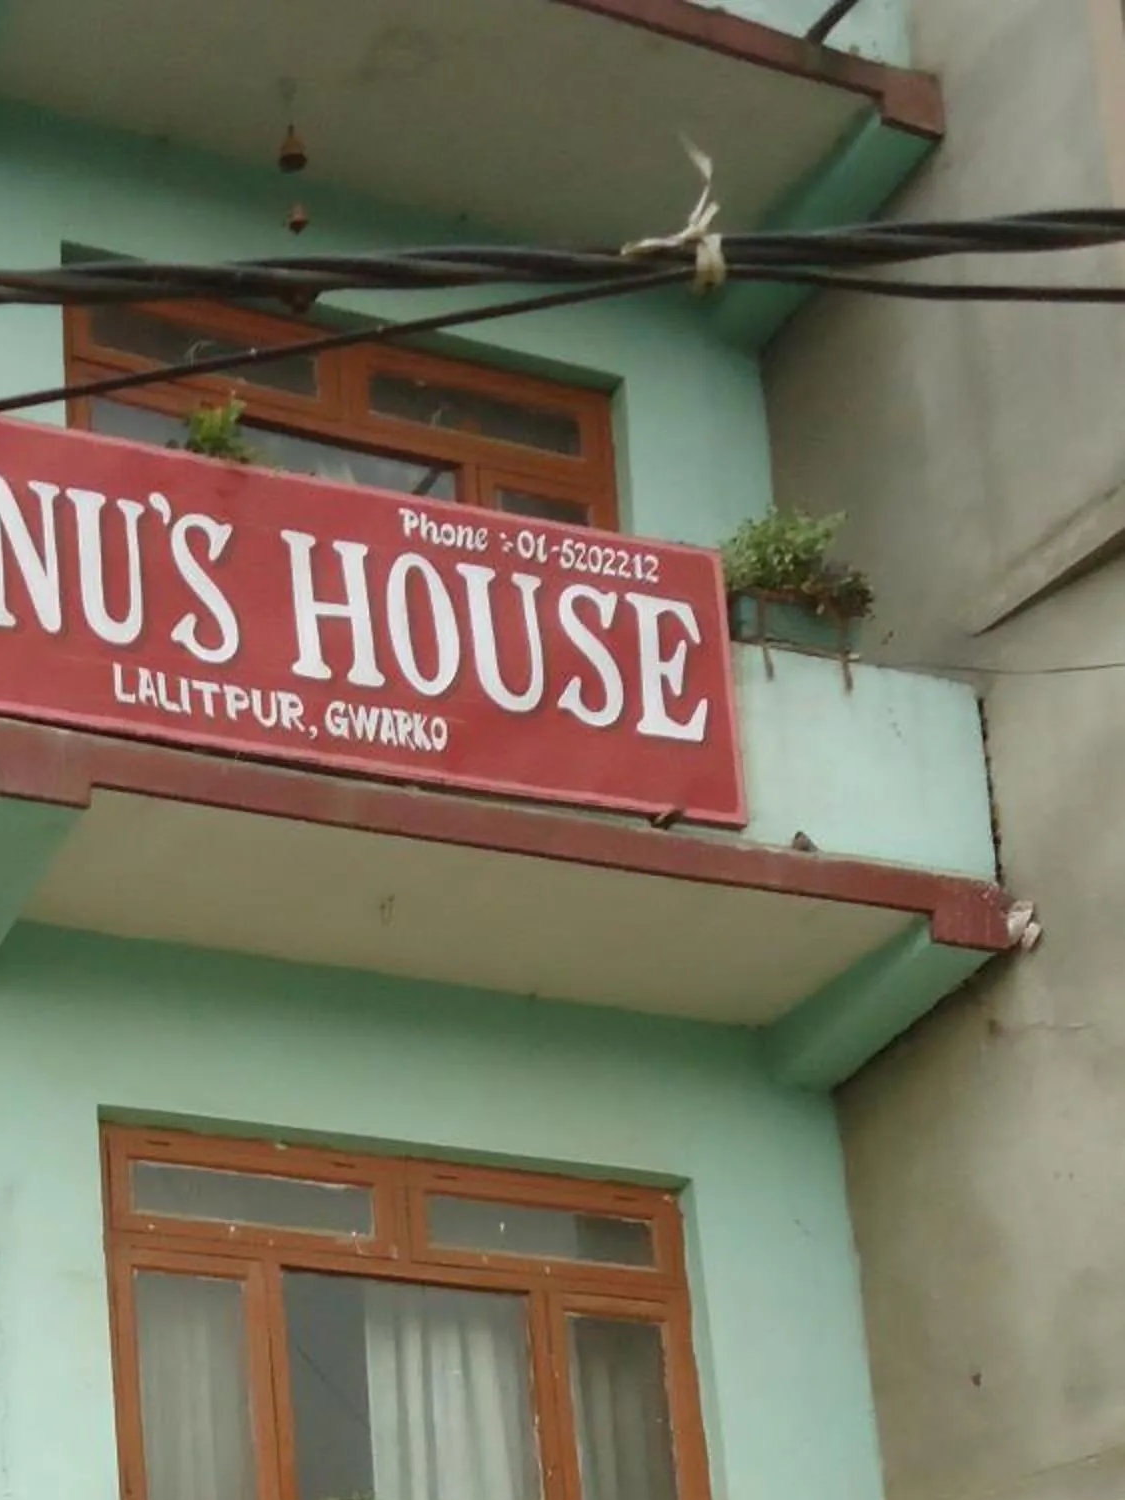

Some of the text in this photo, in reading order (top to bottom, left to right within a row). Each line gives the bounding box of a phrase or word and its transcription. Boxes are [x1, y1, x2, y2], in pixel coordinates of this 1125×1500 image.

[397, 507, 489, 551] Phone
[280, 529, 711, 744] HOUSE
[111, 660, 450, 753] LALITPUR, GWARKO
